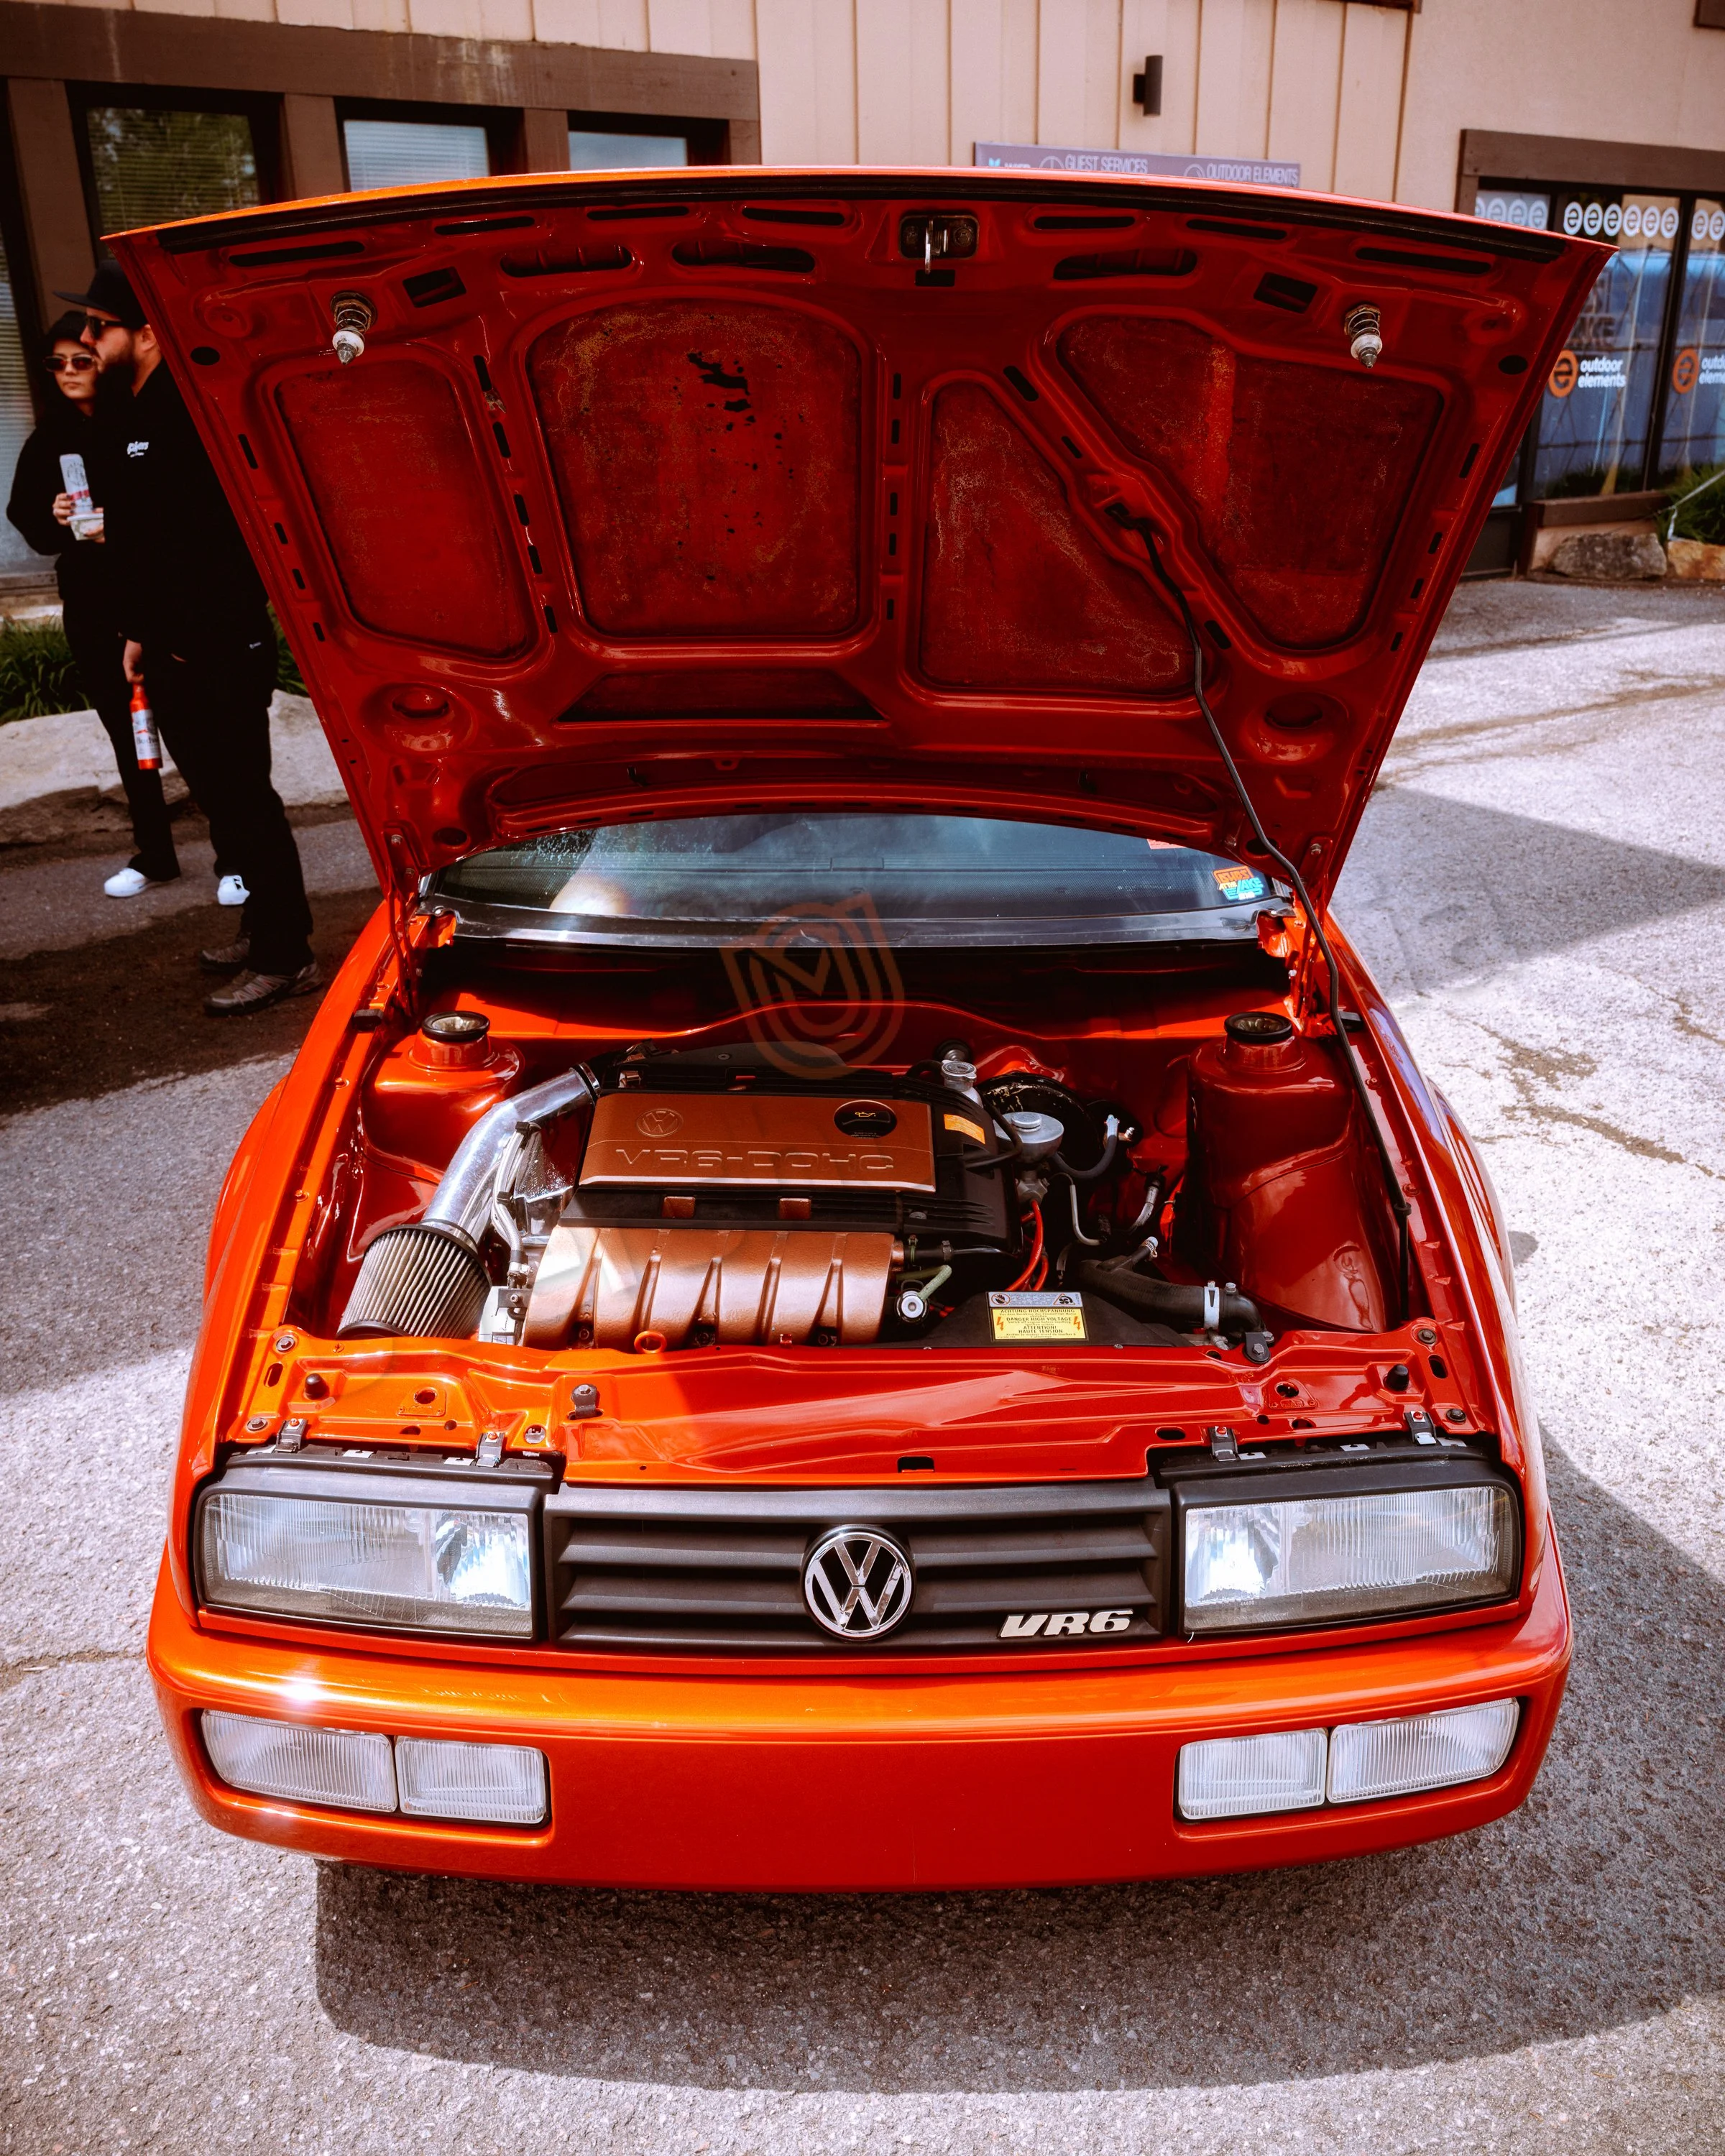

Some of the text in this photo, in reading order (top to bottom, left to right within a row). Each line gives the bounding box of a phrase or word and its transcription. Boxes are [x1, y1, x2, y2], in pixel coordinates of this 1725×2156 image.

[1065, 154, 1149, 173] GUEST SERVICES
[1206, 162, 1300, 185] OUTDOOR ELEMENTS
[1580, 356, 1624, 372] outdoor
[1578, 372, 1627, 388] elements
[804, 1531, 913, 1638] VW
[998, 1608, 1134, 1639] VR6
